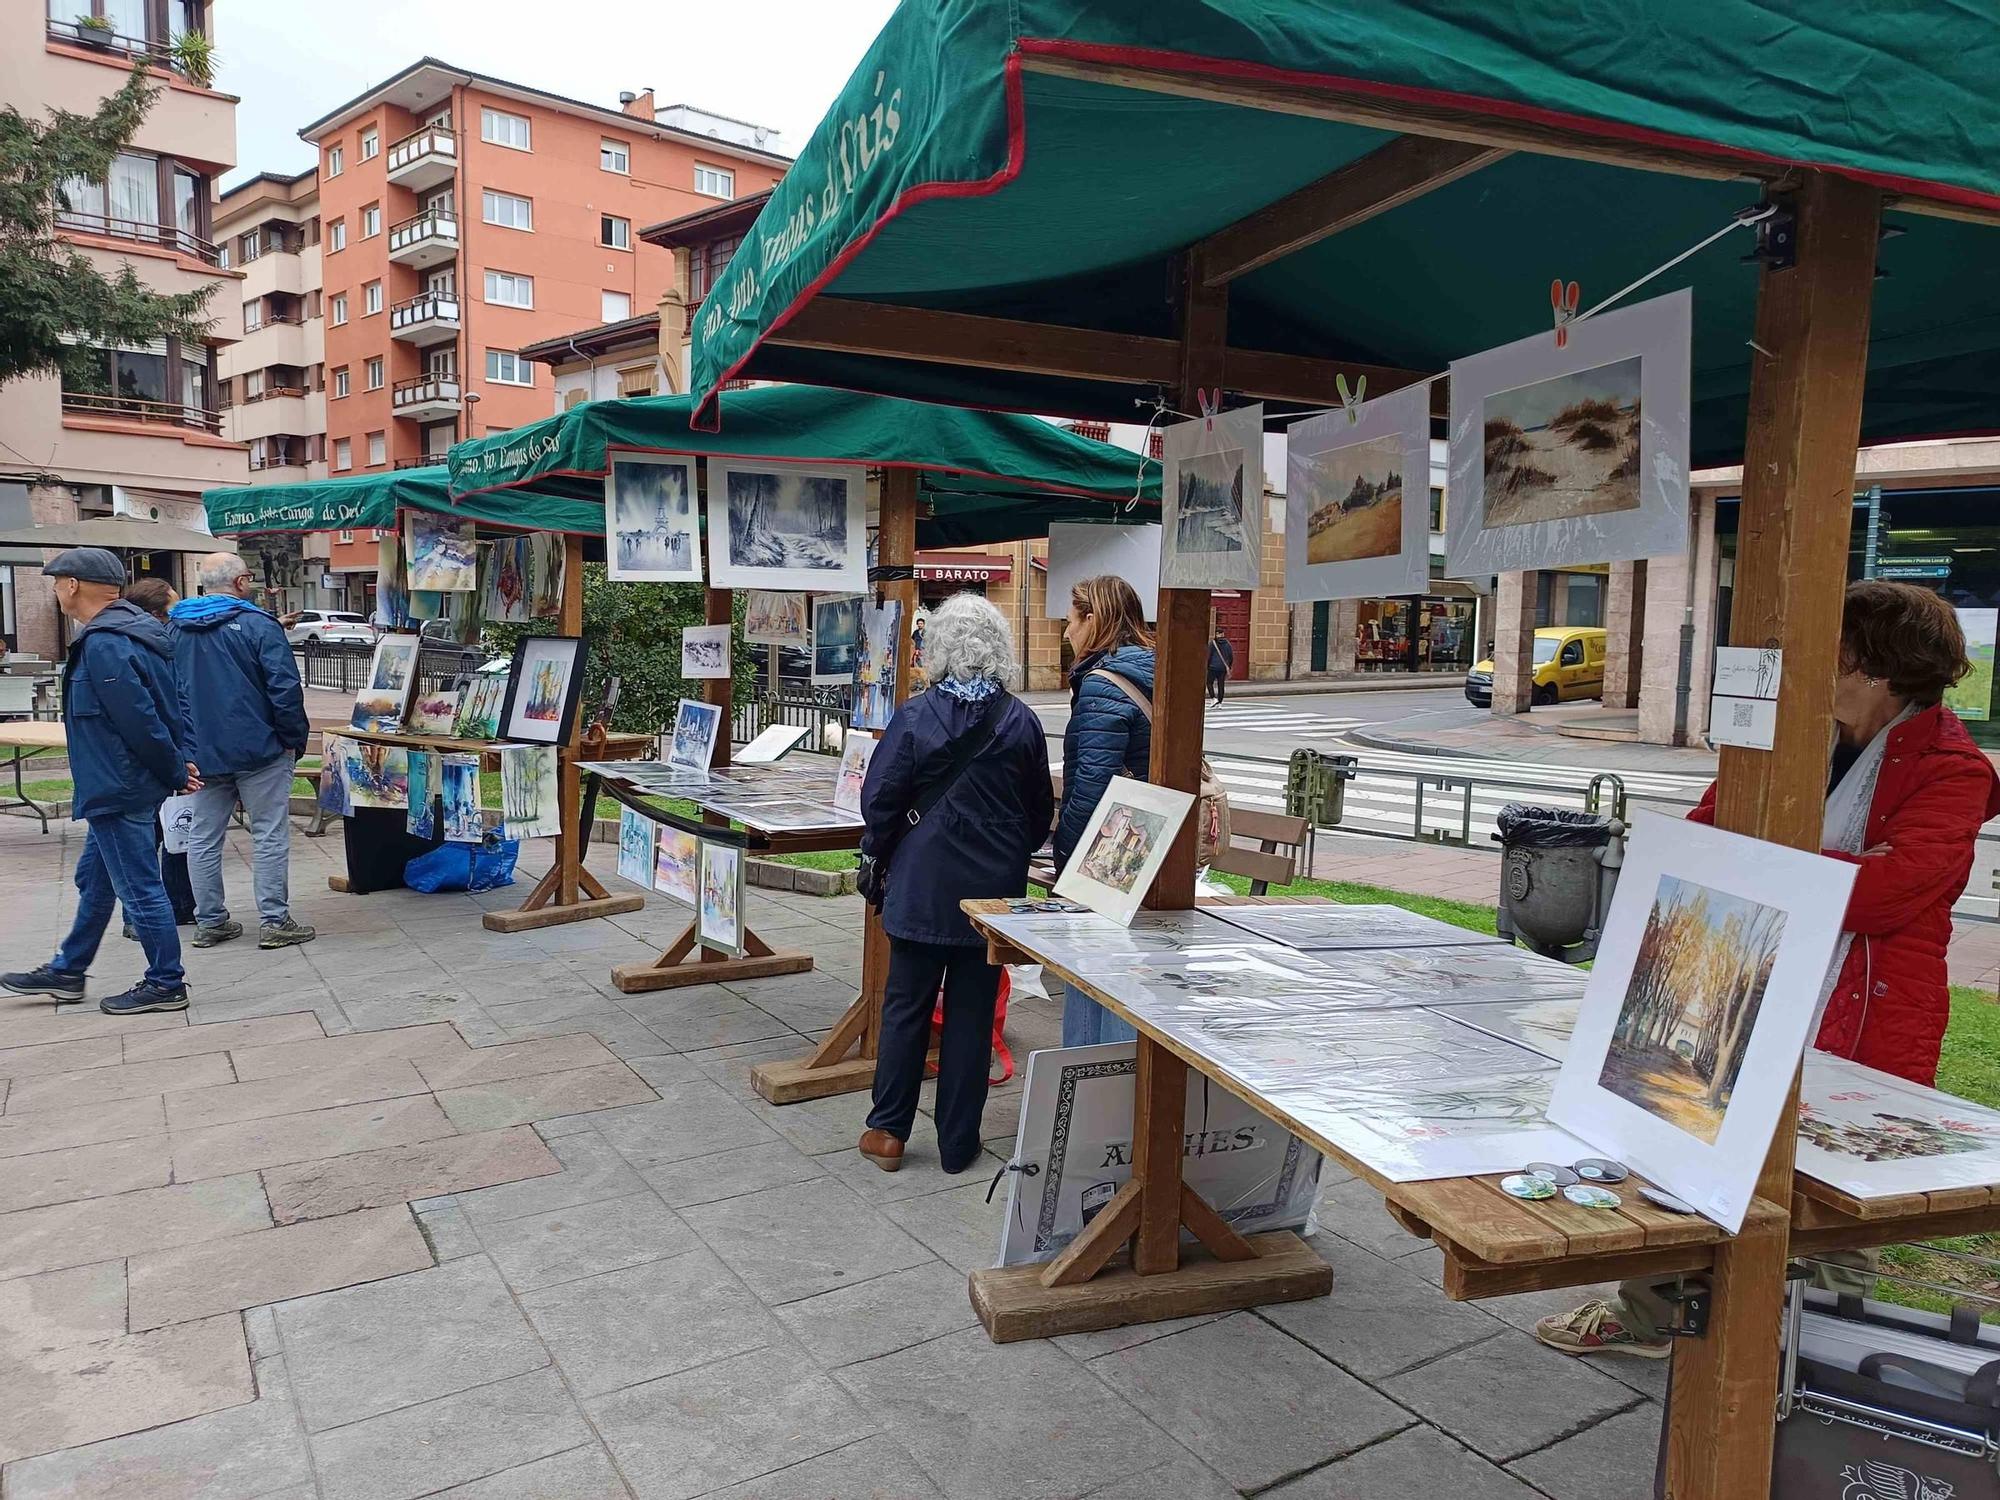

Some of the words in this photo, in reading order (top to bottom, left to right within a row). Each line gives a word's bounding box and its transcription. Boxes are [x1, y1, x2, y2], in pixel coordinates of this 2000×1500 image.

[322, 502, 337, 521] de
[913, 570, 928, 579] EL
[935, 569, 990, 580] BARATO
